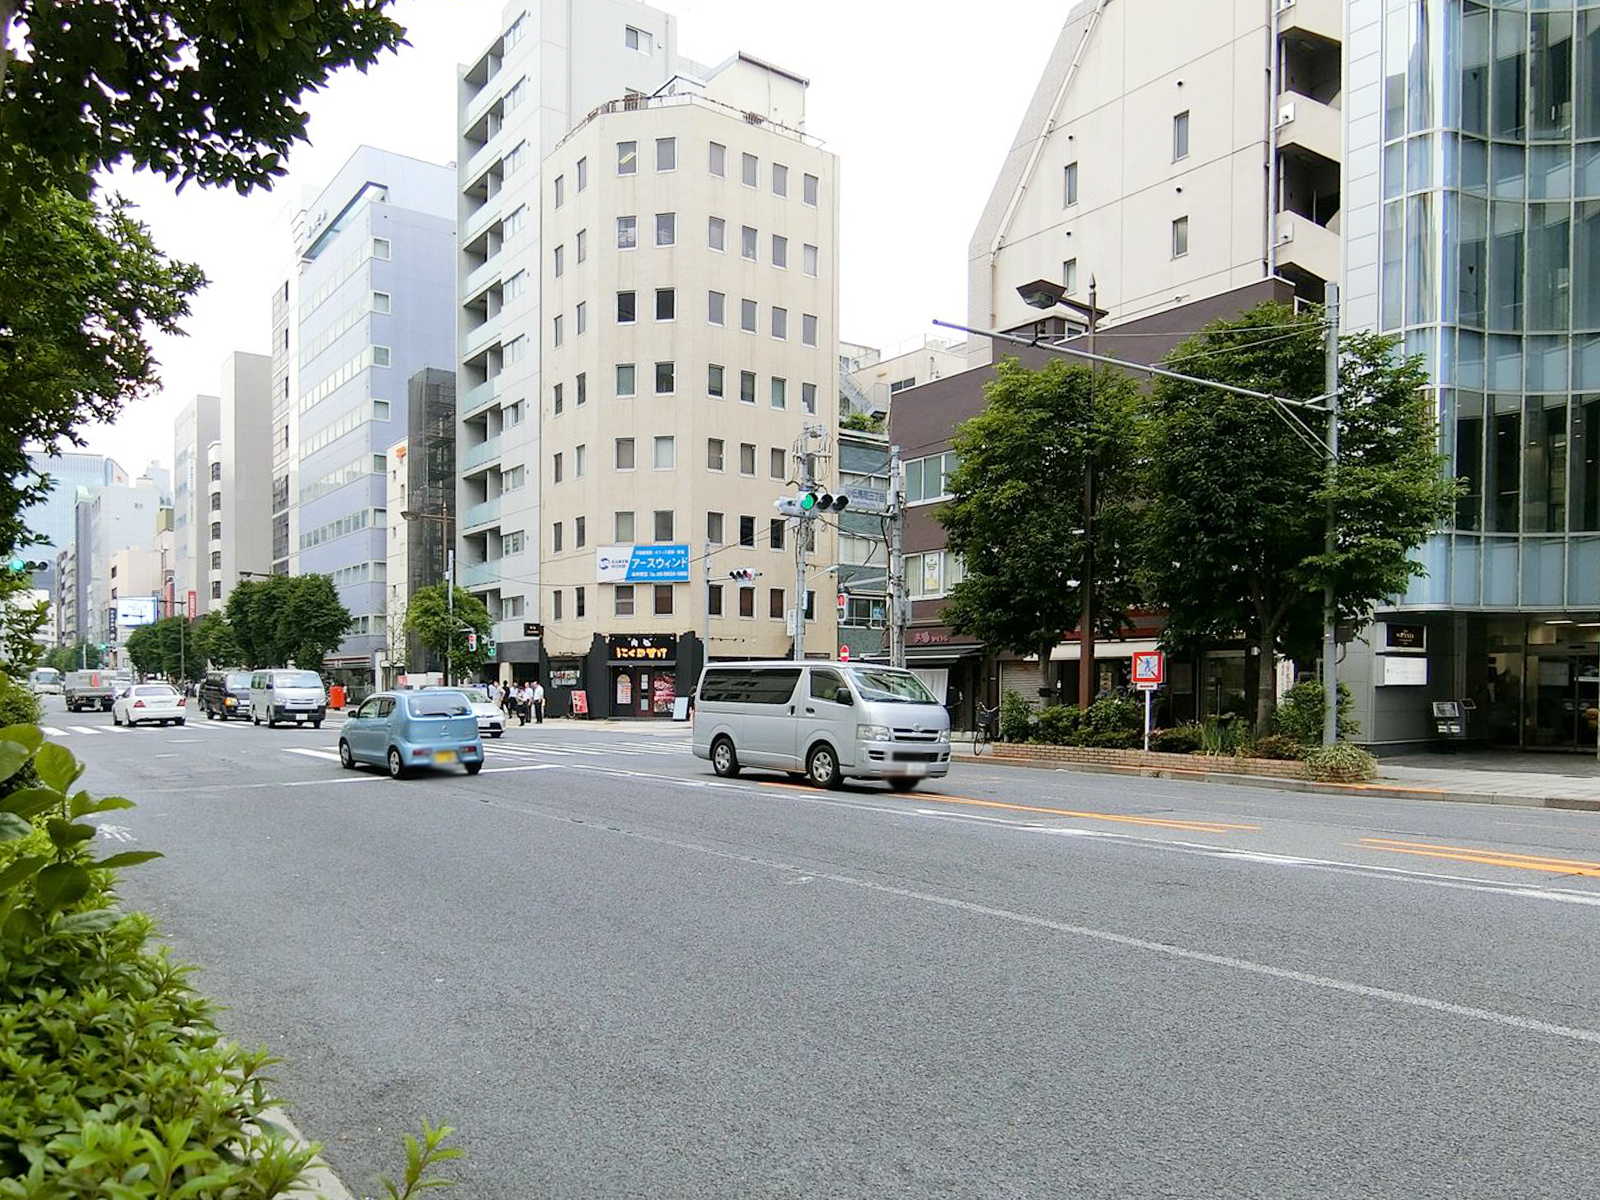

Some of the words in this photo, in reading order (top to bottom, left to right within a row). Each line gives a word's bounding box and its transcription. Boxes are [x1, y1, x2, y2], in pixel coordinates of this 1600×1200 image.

[631, 557, 688, 569] アースウィンド
